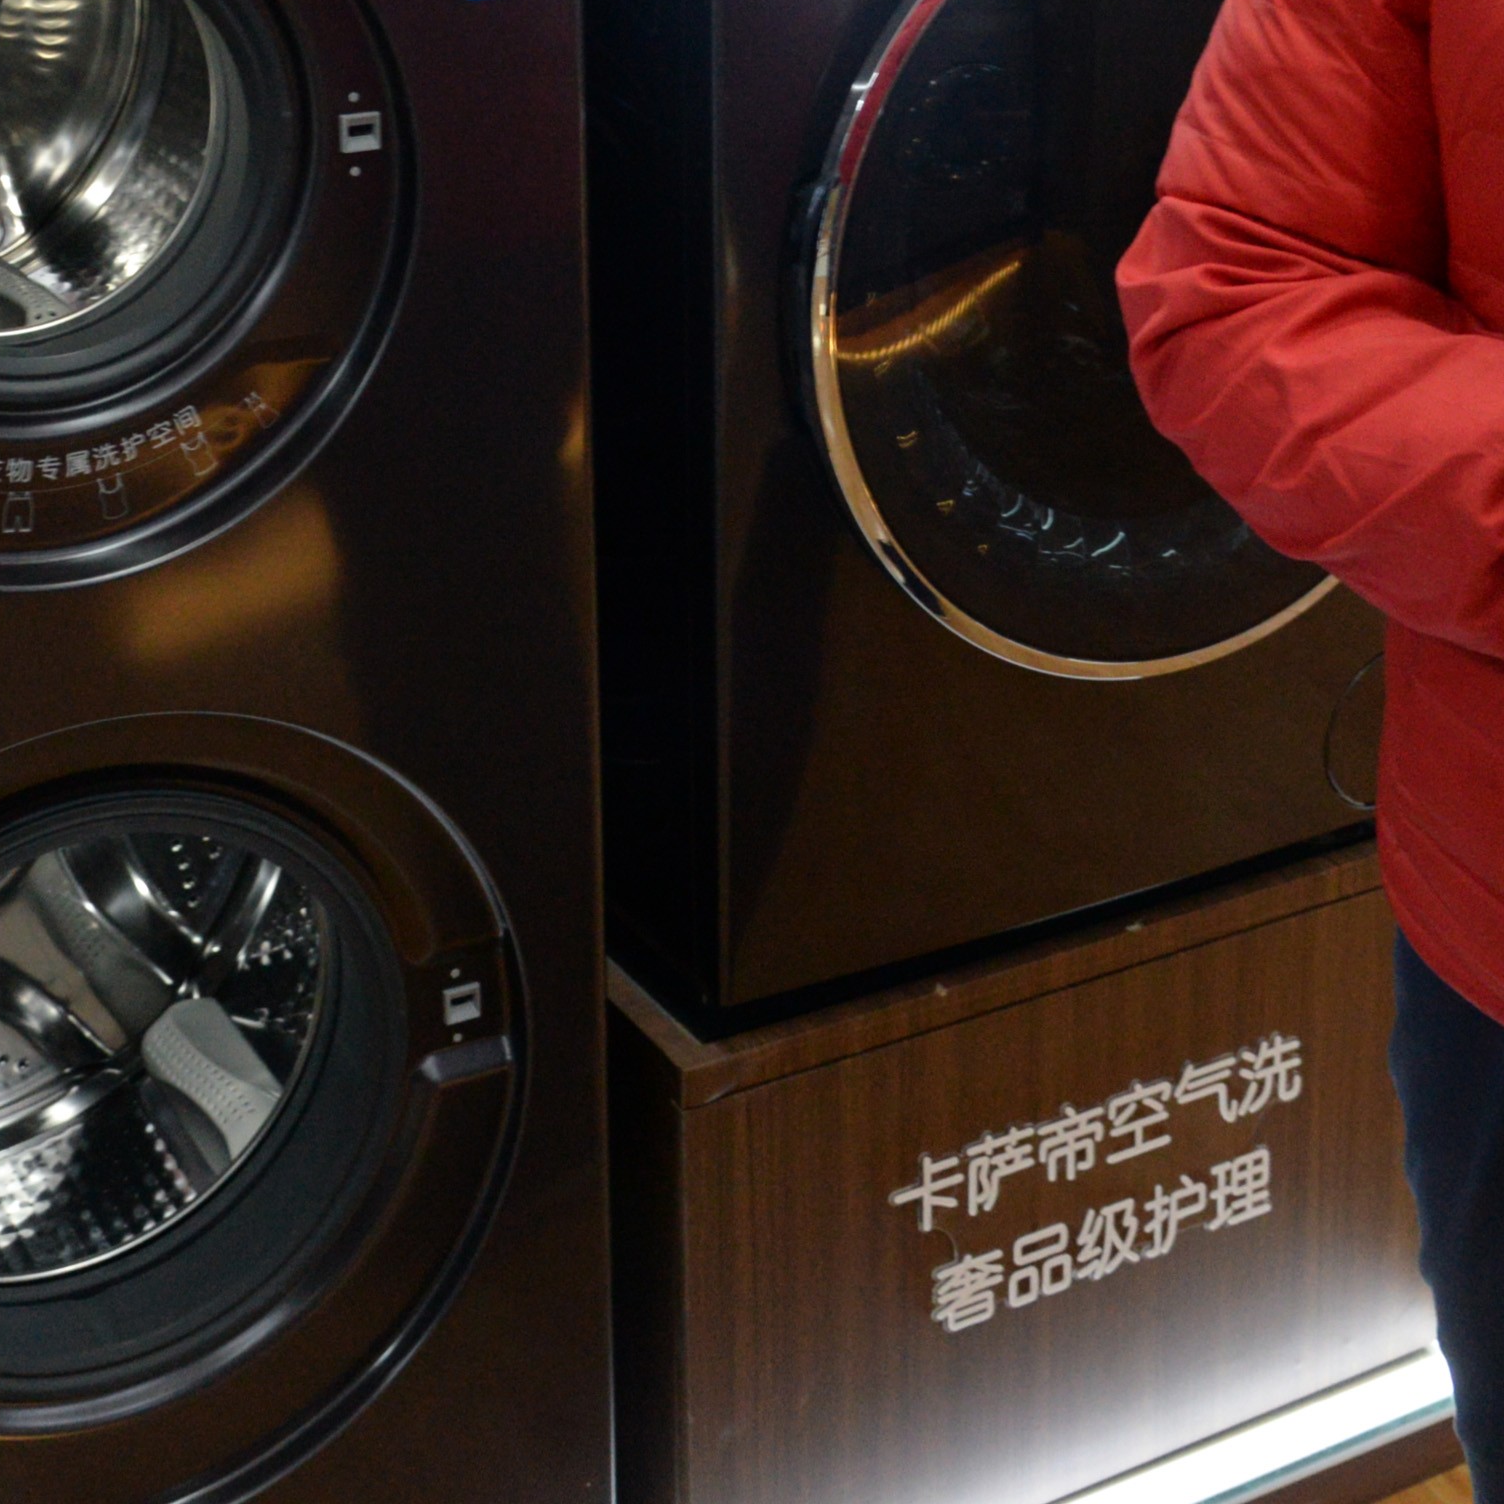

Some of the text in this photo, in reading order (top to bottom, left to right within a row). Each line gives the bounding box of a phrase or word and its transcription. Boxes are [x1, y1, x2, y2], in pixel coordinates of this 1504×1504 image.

[890, 1032, 1303, 1232] 卡萨帝空气洗
[932, 1148, 1272, 1333] 奢品级护理
